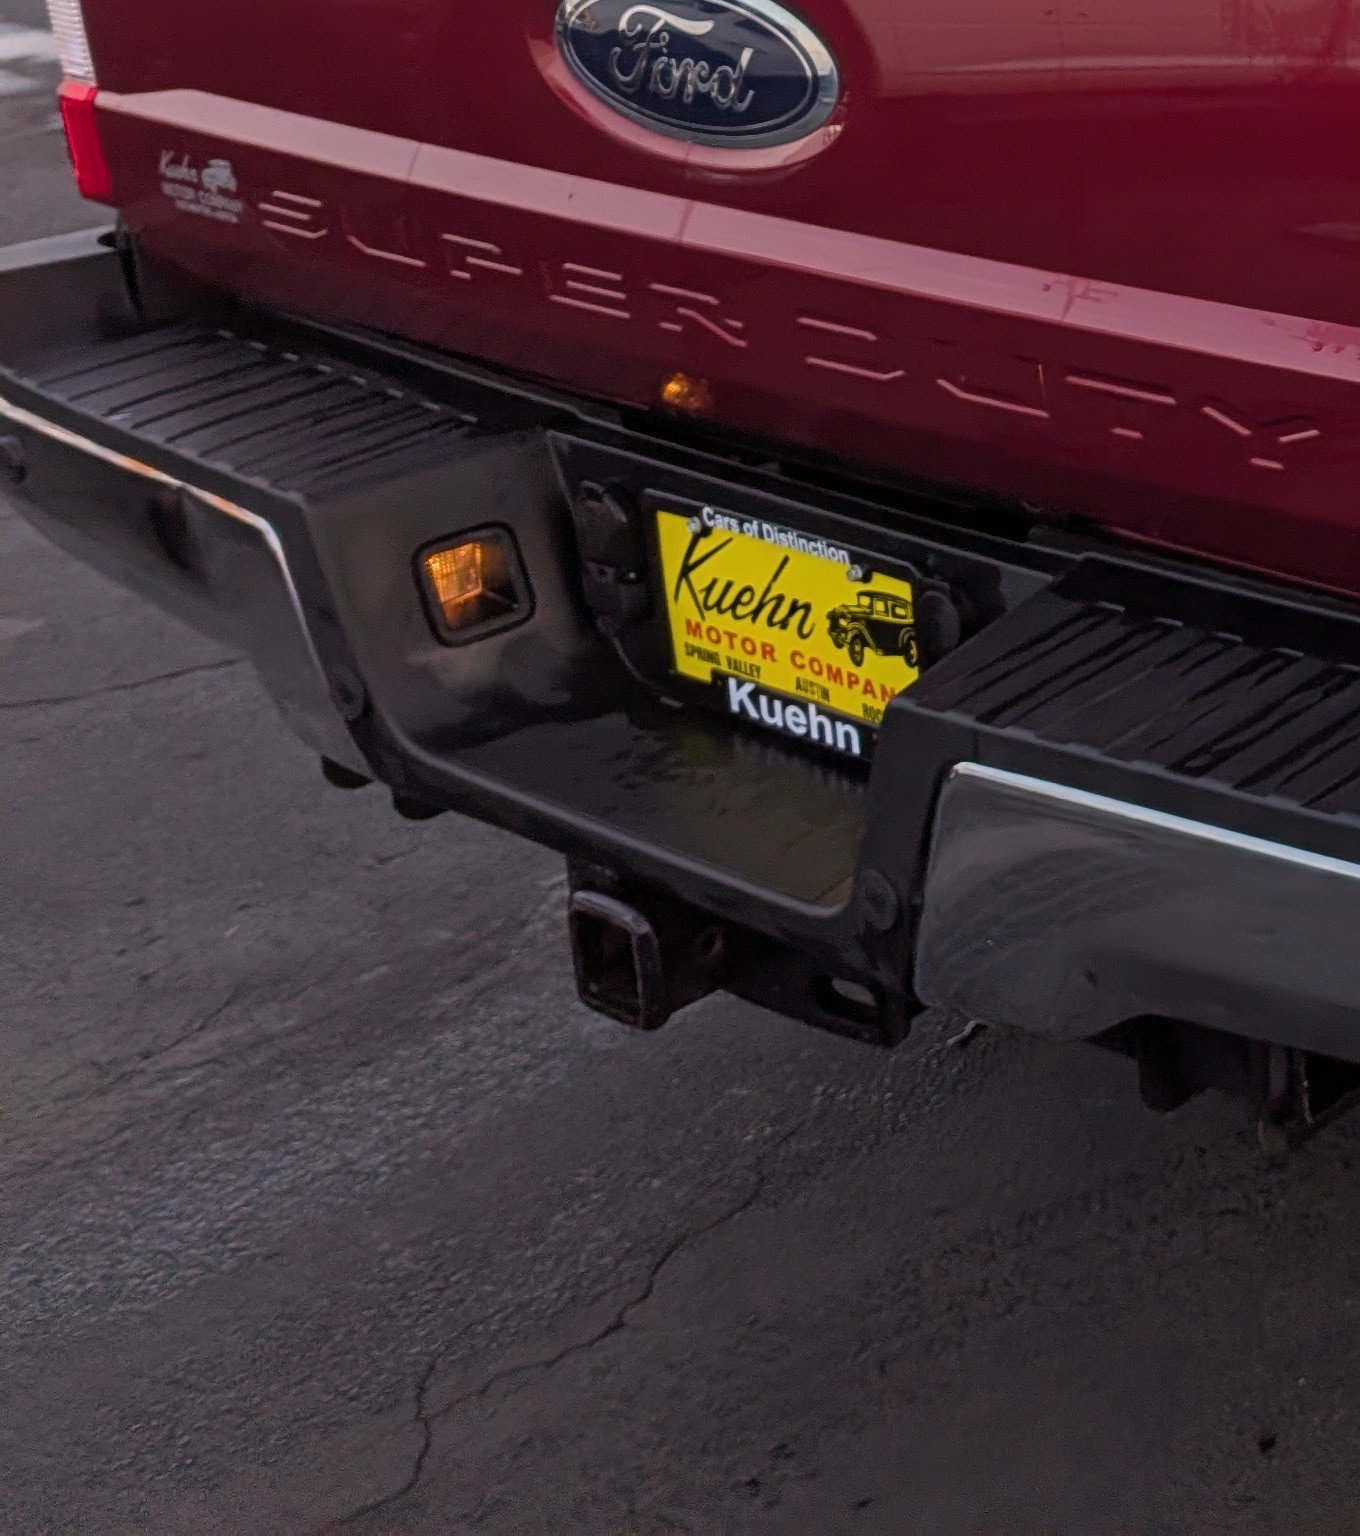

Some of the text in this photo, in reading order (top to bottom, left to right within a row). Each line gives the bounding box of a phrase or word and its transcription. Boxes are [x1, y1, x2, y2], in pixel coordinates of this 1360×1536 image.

[610, 4, 754, 112] Ford
[256, 188, 1322, 471] SUPER DUTY
[702, 506, 850, 564] Cars of Distinction
[674, 530, 816, 639] Kuehn
[684, 641, 830, 702] SPRING VALLEY AUSTIN
[685, 618, 897, 702] MOTOR COMPAN
[728, 677, 861, 756] Kuehn
